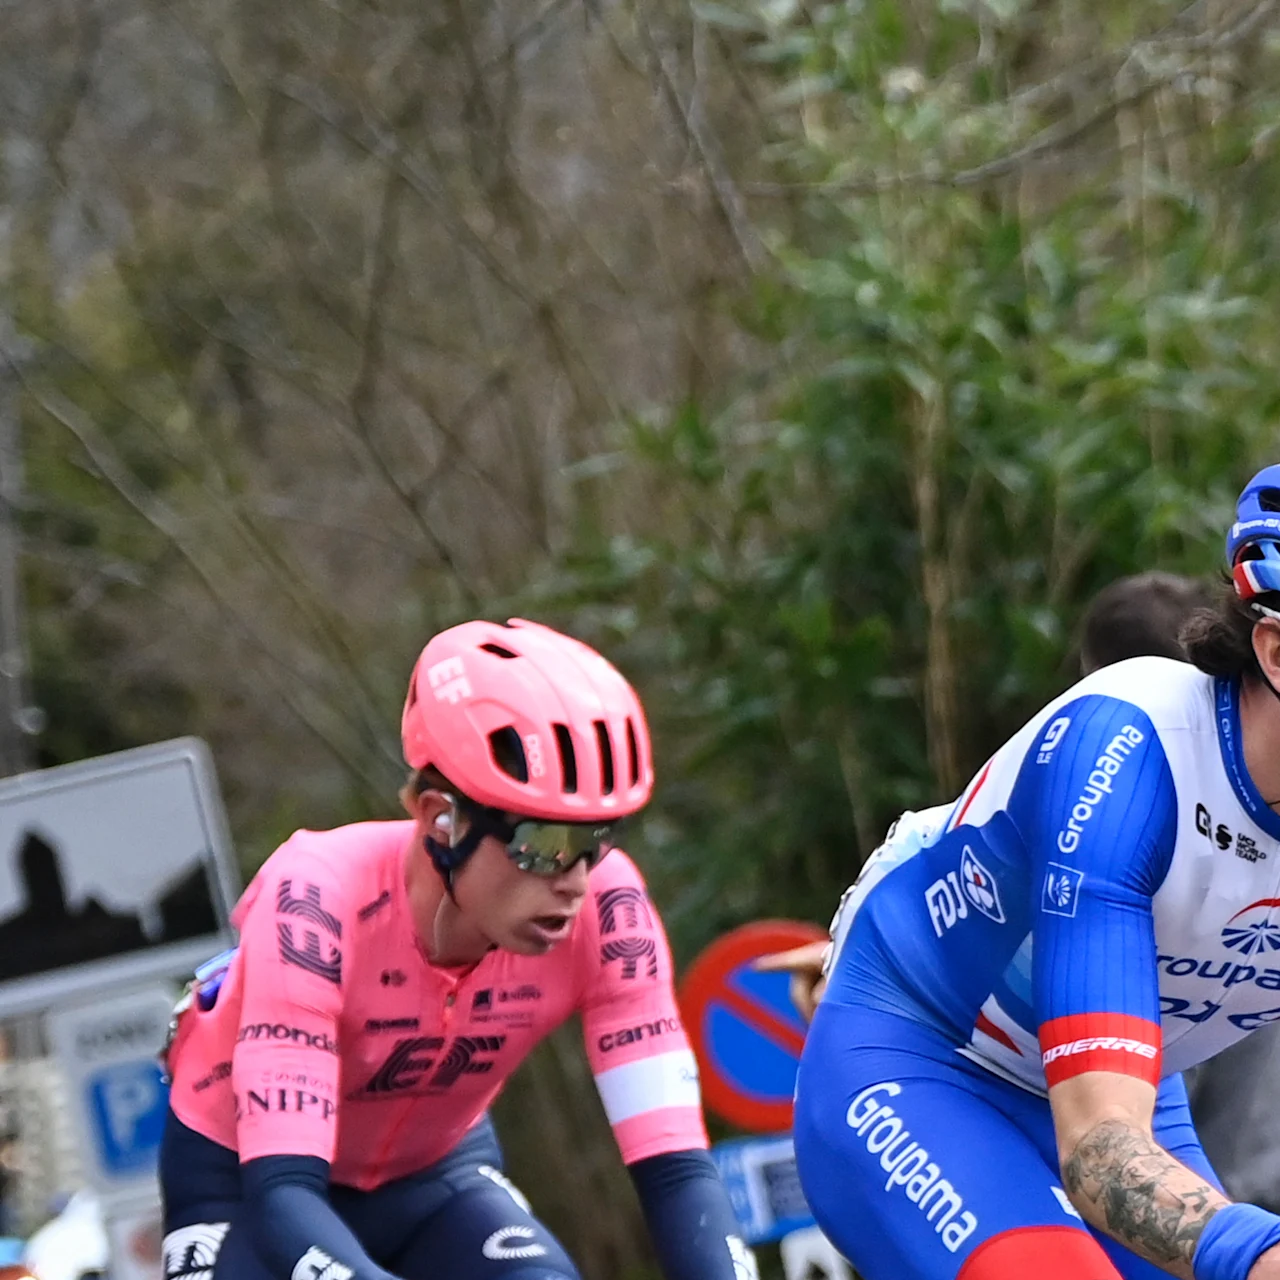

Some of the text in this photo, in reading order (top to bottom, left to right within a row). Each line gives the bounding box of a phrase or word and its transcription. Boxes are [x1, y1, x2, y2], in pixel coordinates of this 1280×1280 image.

[428, 655, 474, 706] EF
[1057, 724, 1145, 855] Groupama
[1235, 848, 1258, 864] TEAM
[1236, 841, 1267, 860] WORLD
[1237, 832, 1256, 847] UCI
[277, 879, 342, 985] EF
[924, 868, 969, 939] FDJ
[365, 1035, 506, 1093] EF
[846, 1081, 979, 1253] Groupama
